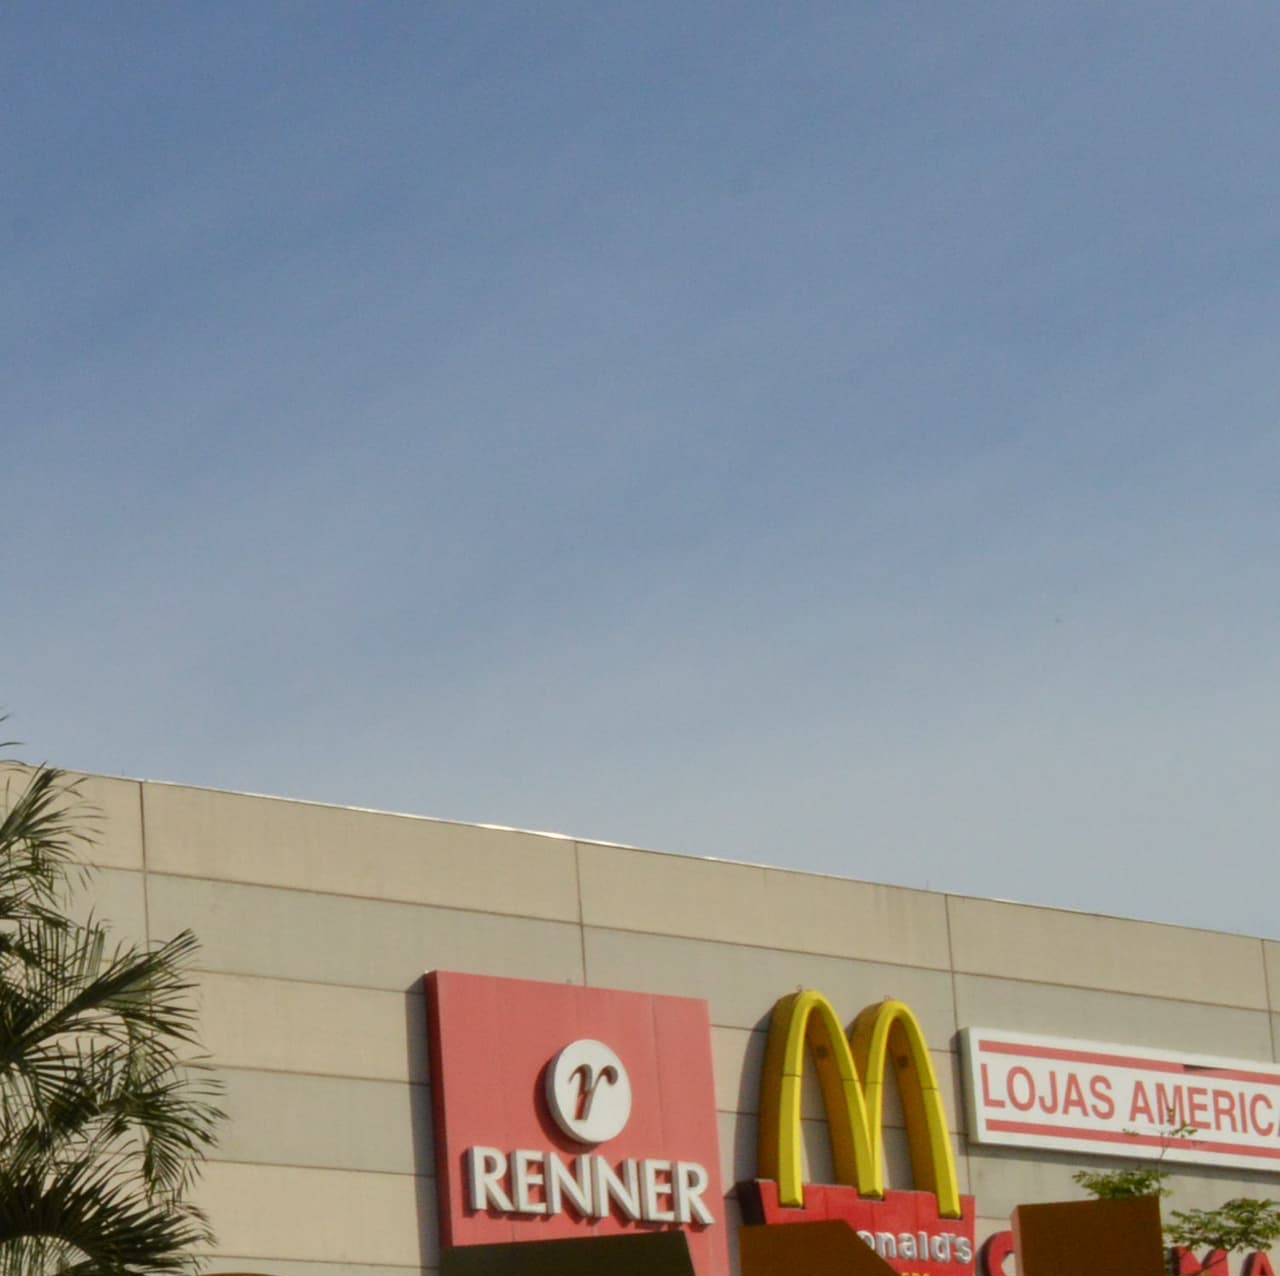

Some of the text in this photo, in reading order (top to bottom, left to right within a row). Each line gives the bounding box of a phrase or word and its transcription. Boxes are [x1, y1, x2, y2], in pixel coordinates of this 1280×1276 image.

[980, 1063, 1280, 1137] LOJAS AMERIC
[469, 1145, 716, 1224] RENNER
